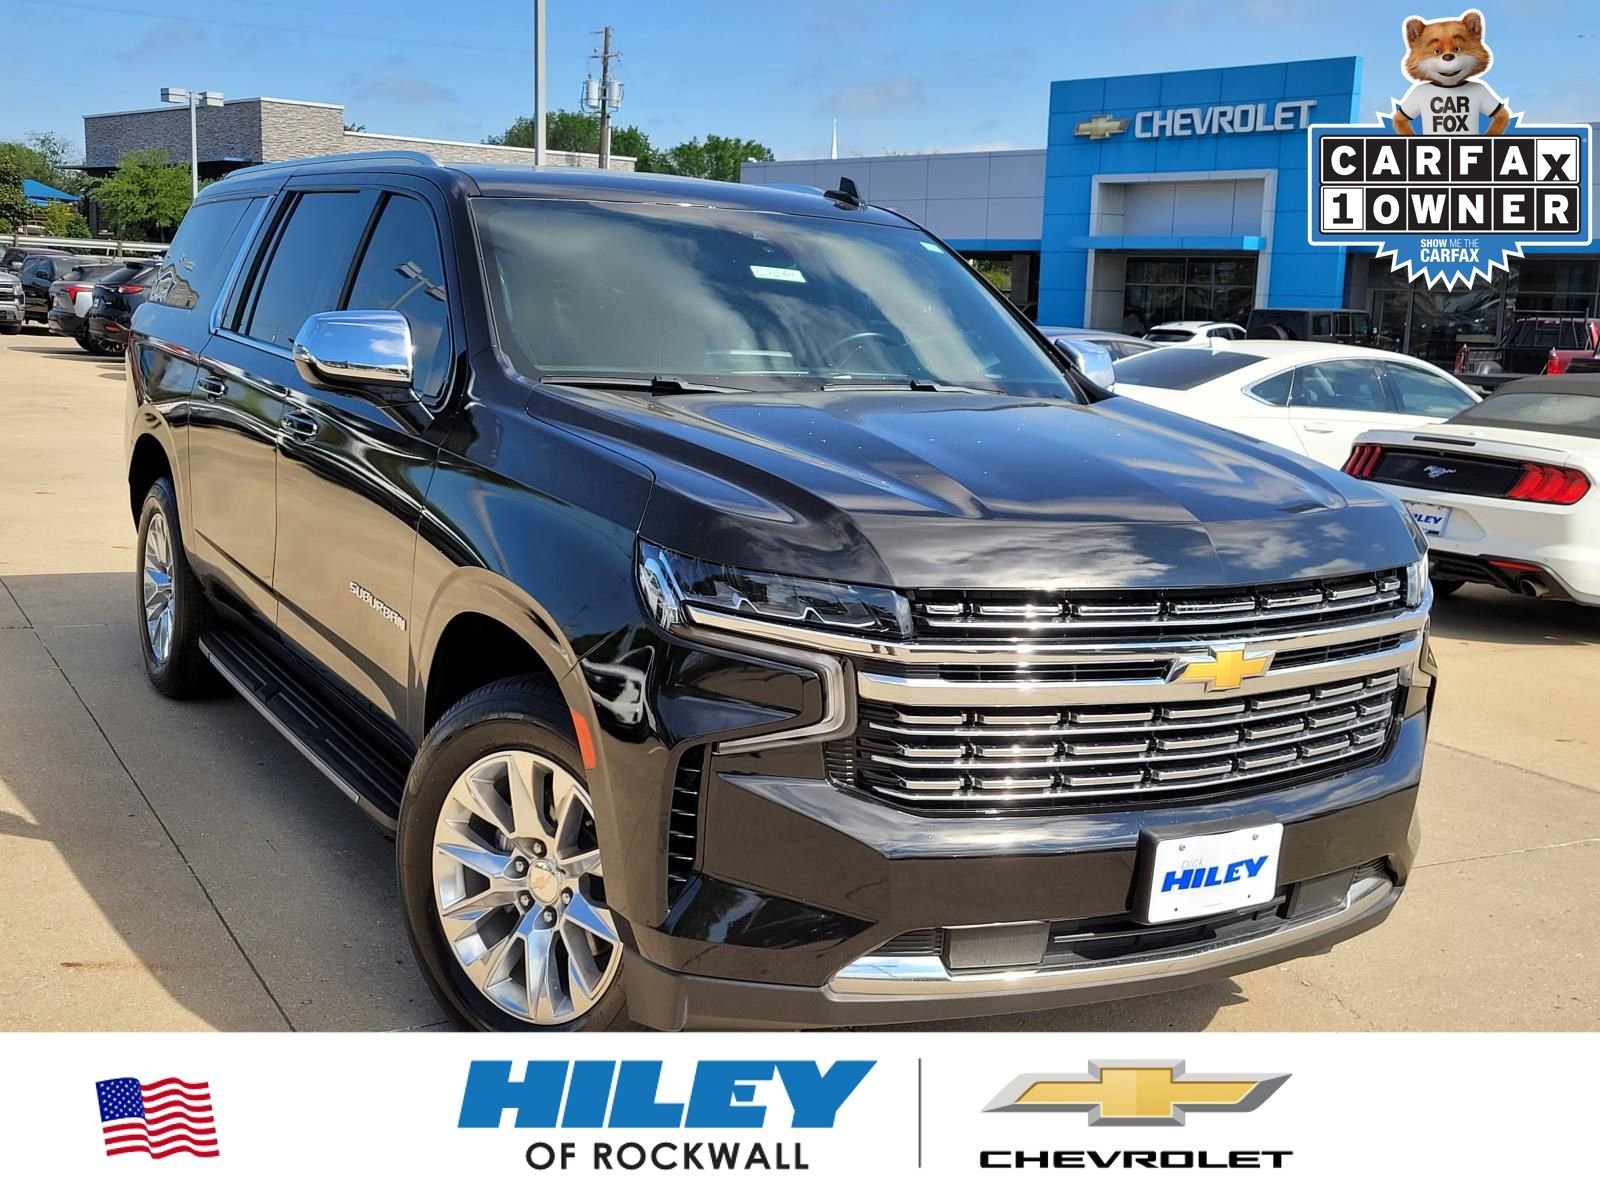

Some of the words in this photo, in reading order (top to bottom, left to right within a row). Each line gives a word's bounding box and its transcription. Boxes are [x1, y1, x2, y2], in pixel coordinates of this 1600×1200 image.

[1134, 99, 1318, 138] CHEVROLET
[349, 580, 407, 631] SUBURBAN
[1161, 855, 1269, 893] HILEY
